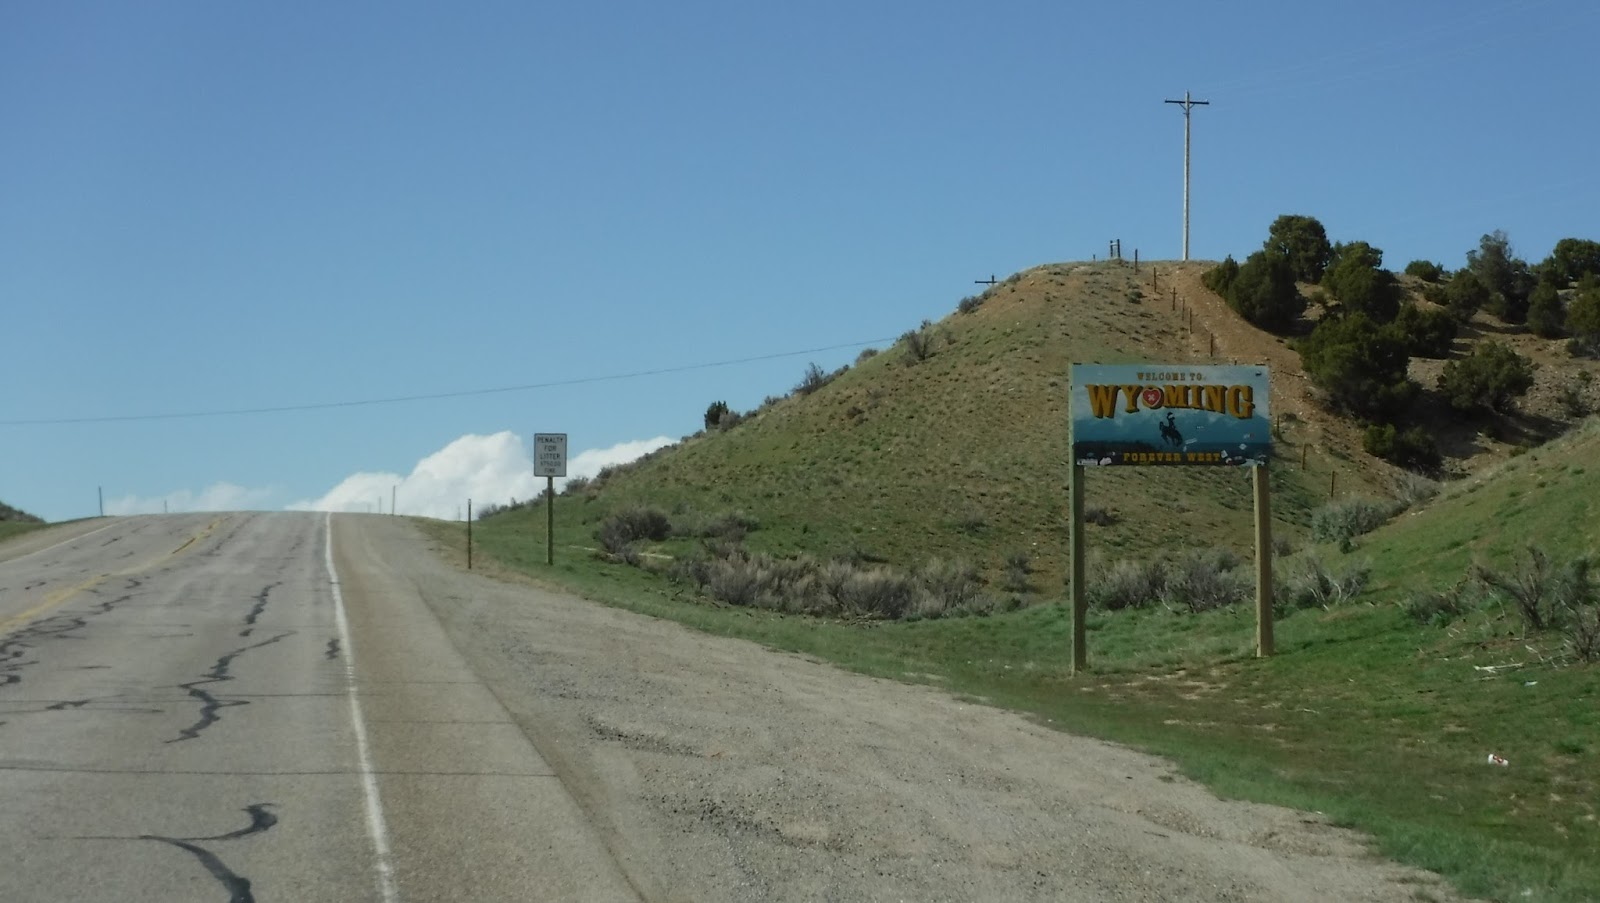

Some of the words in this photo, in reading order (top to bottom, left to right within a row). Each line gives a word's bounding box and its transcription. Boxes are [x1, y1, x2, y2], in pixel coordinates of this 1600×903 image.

[1137, 372, 1186, 381] WELCOME
[1086, 384, 1255, 419] WYOMING
[1123, 452, 1181, 462] FOREVER
[1187, 452, 1221, 462] WEST
